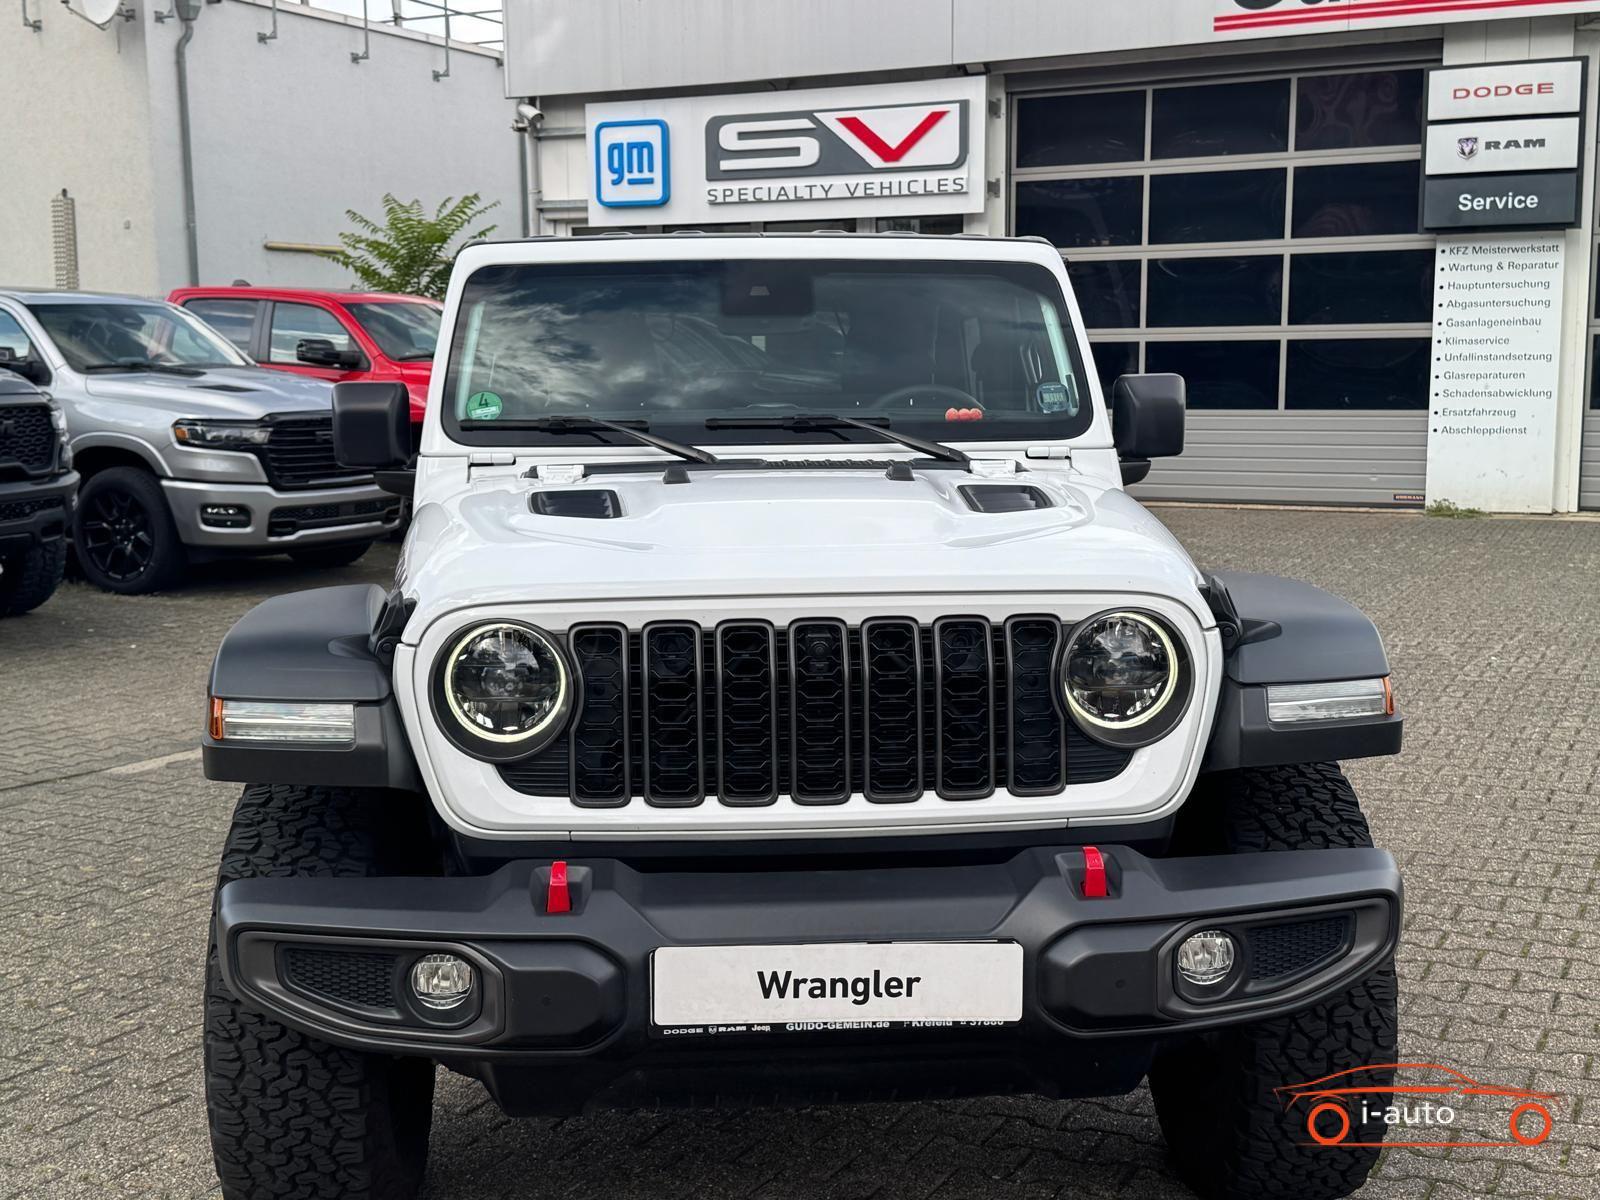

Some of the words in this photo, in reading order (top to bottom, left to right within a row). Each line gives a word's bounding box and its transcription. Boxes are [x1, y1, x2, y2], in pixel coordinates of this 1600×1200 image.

[1453, 82, 1554, 100] DODGE
[1484, 138, 1546, 151] RAM
[607, 140, 655, 187] gm
[707, 183, 833, 203] SPECIALTY
[845, 176, 965, 198] VEHICLES
[1458, 192, 1539, 211] Service
[1449, 246, 1469, 256] KFZ
[1471, 244, 1560, 256] Meisterwerkstatt
[1448, 263, 1493, 273] Wartung
[1496, 261, 1504, 271] &
[1507, 260, 1560, 272] Reparatur
[1447, 280, 1551, 292] Hauptuntersuchung
[1446, 298, 1551, 310] Abgasuntersuchung
[1445, 317, 1542, 328] Gasanlageneinbau
[1445, 336, 1510, 346] Klimaservice
[1444, 352, 1553, 363] Unfallinstandsetzung
[1443, 370, 1526, 381] Glasreparaturen
[478, 392, 489, 408] 4
[1442, 388, 1553, 400] Schadensabwicklung
[1442, 407, 1517, 418] Ersatzfahrzeug
[1440, 425, 1527, 436] Abschleppdienst
[756, 969, 922, 1006] Wrangler
[751, 1024, 771, 1032] Jeep
[785, 1020, 890, 1031] GUIDO-GEMEIN.de
